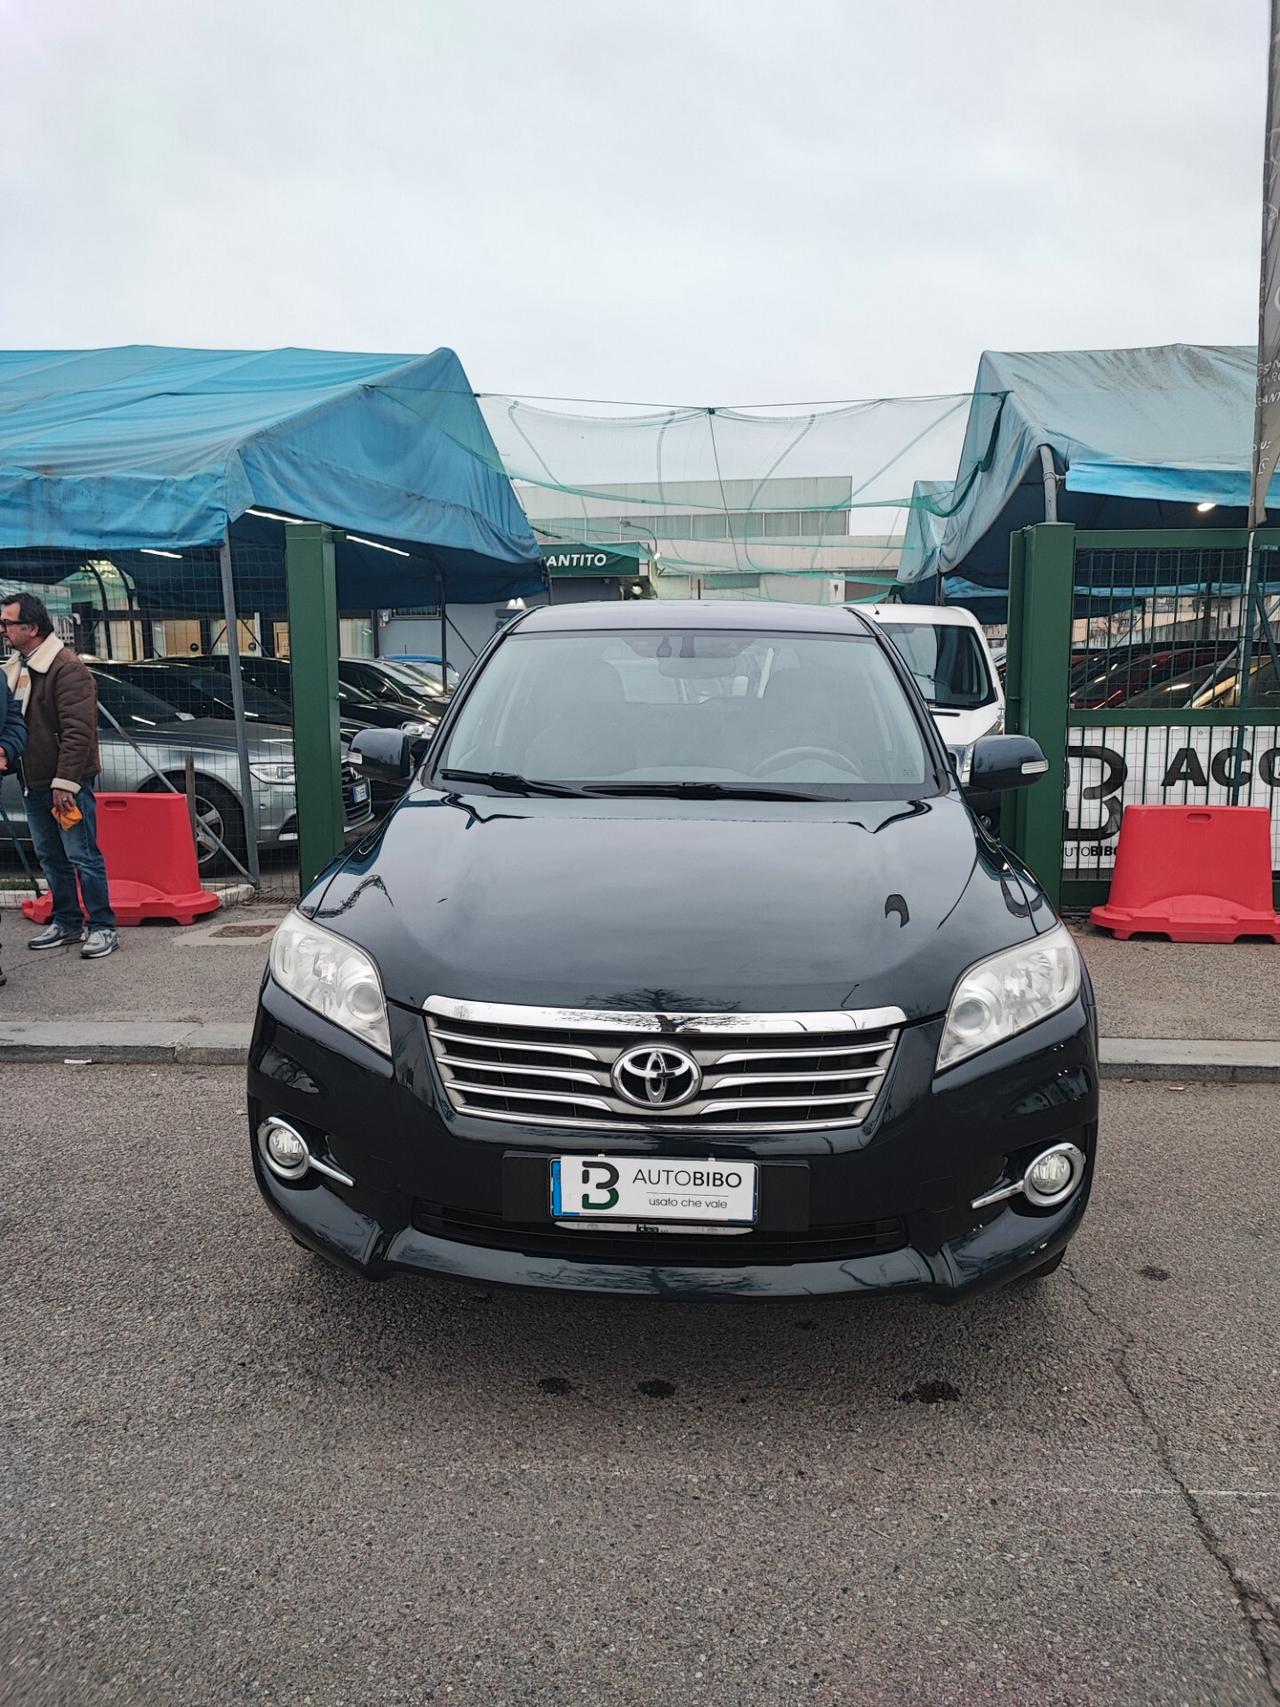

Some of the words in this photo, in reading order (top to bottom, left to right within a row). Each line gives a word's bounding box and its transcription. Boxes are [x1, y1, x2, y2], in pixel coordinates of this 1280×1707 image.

[543, 553, 607, 567] ANTITO
[632, 1168, 742, 1189] AUTOBIBO
[648, 1197, 679, 1207] usato
[680, 1197, 702, 1208] che
[704, 1199, 728, 1209] vale
